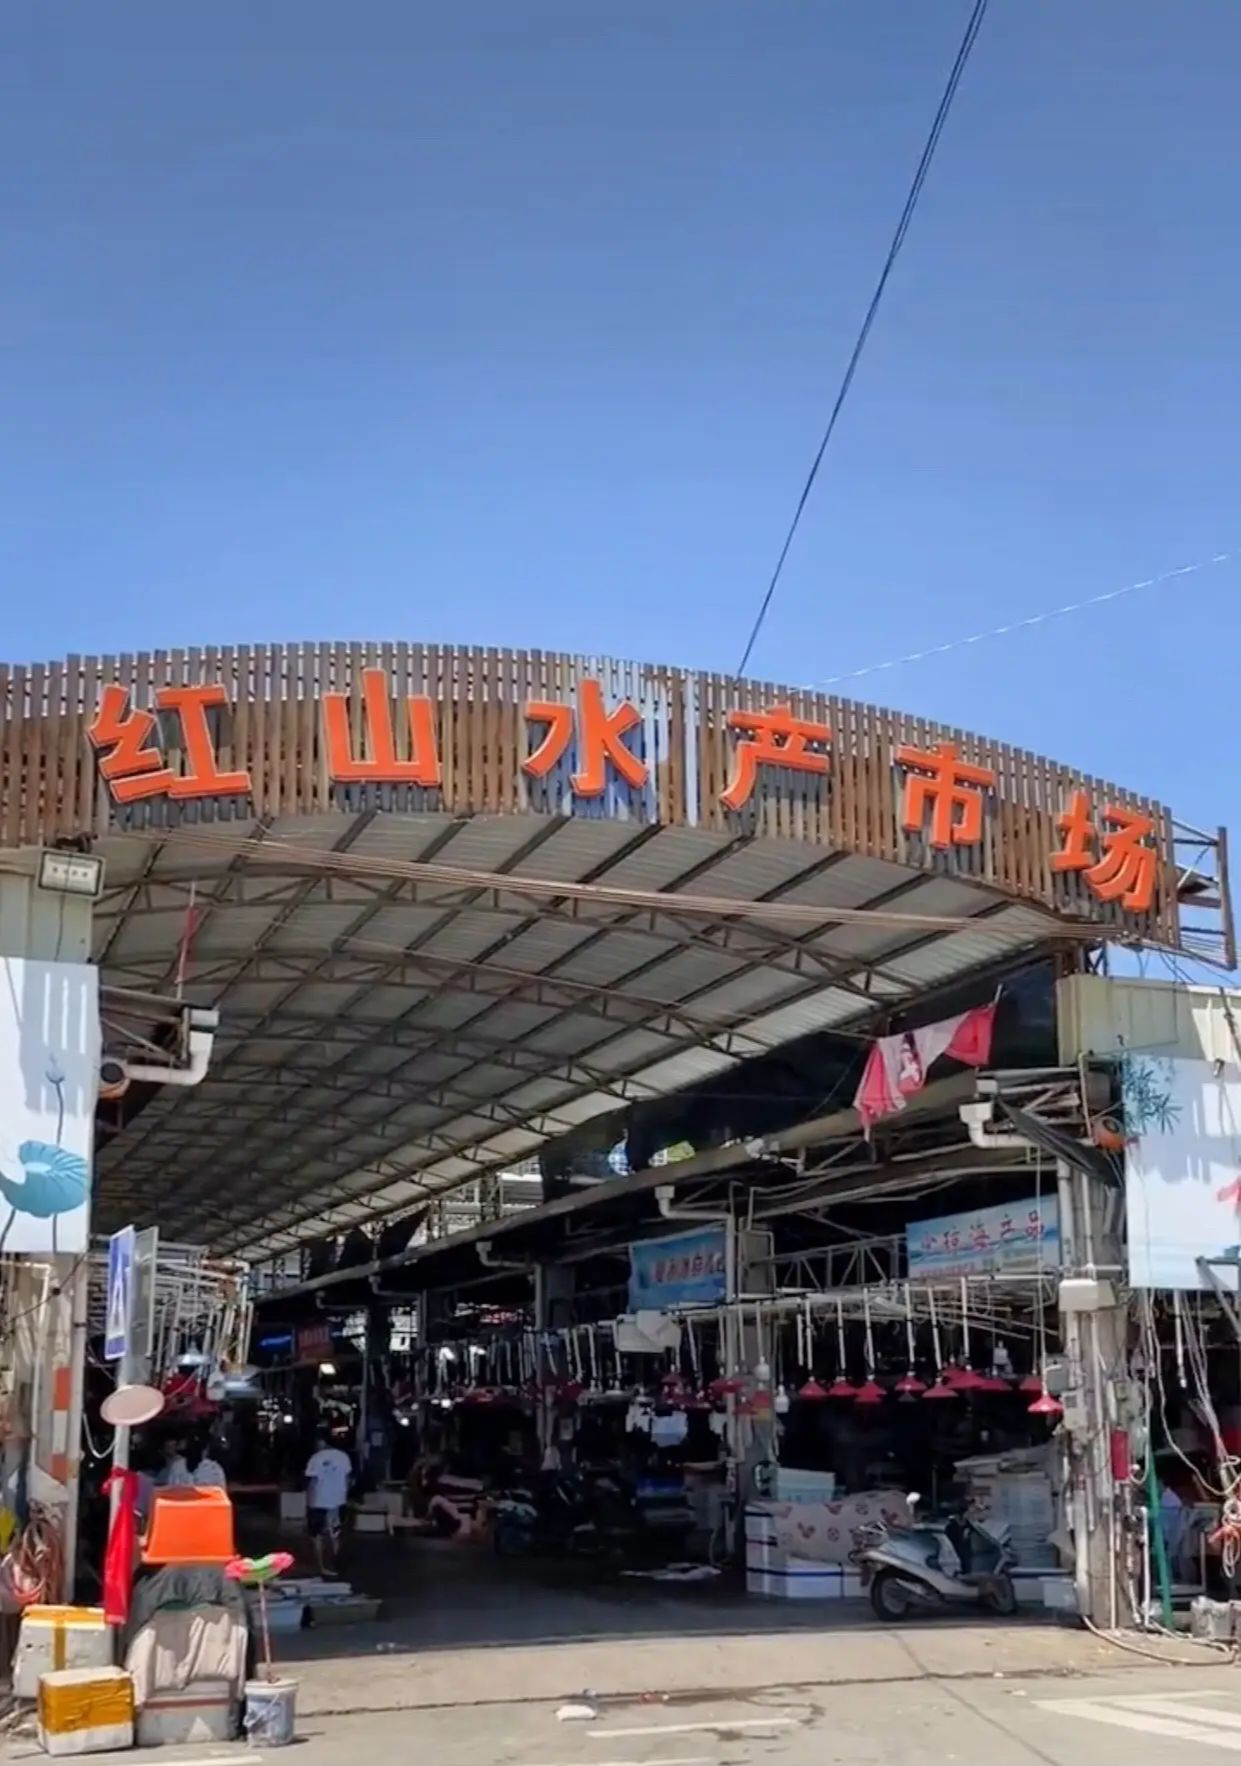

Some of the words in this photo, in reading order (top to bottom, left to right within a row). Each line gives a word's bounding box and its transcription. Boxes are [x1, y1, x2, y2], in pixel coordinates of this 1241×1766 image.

[87, 667, 1157, 913] 红山水产市场
